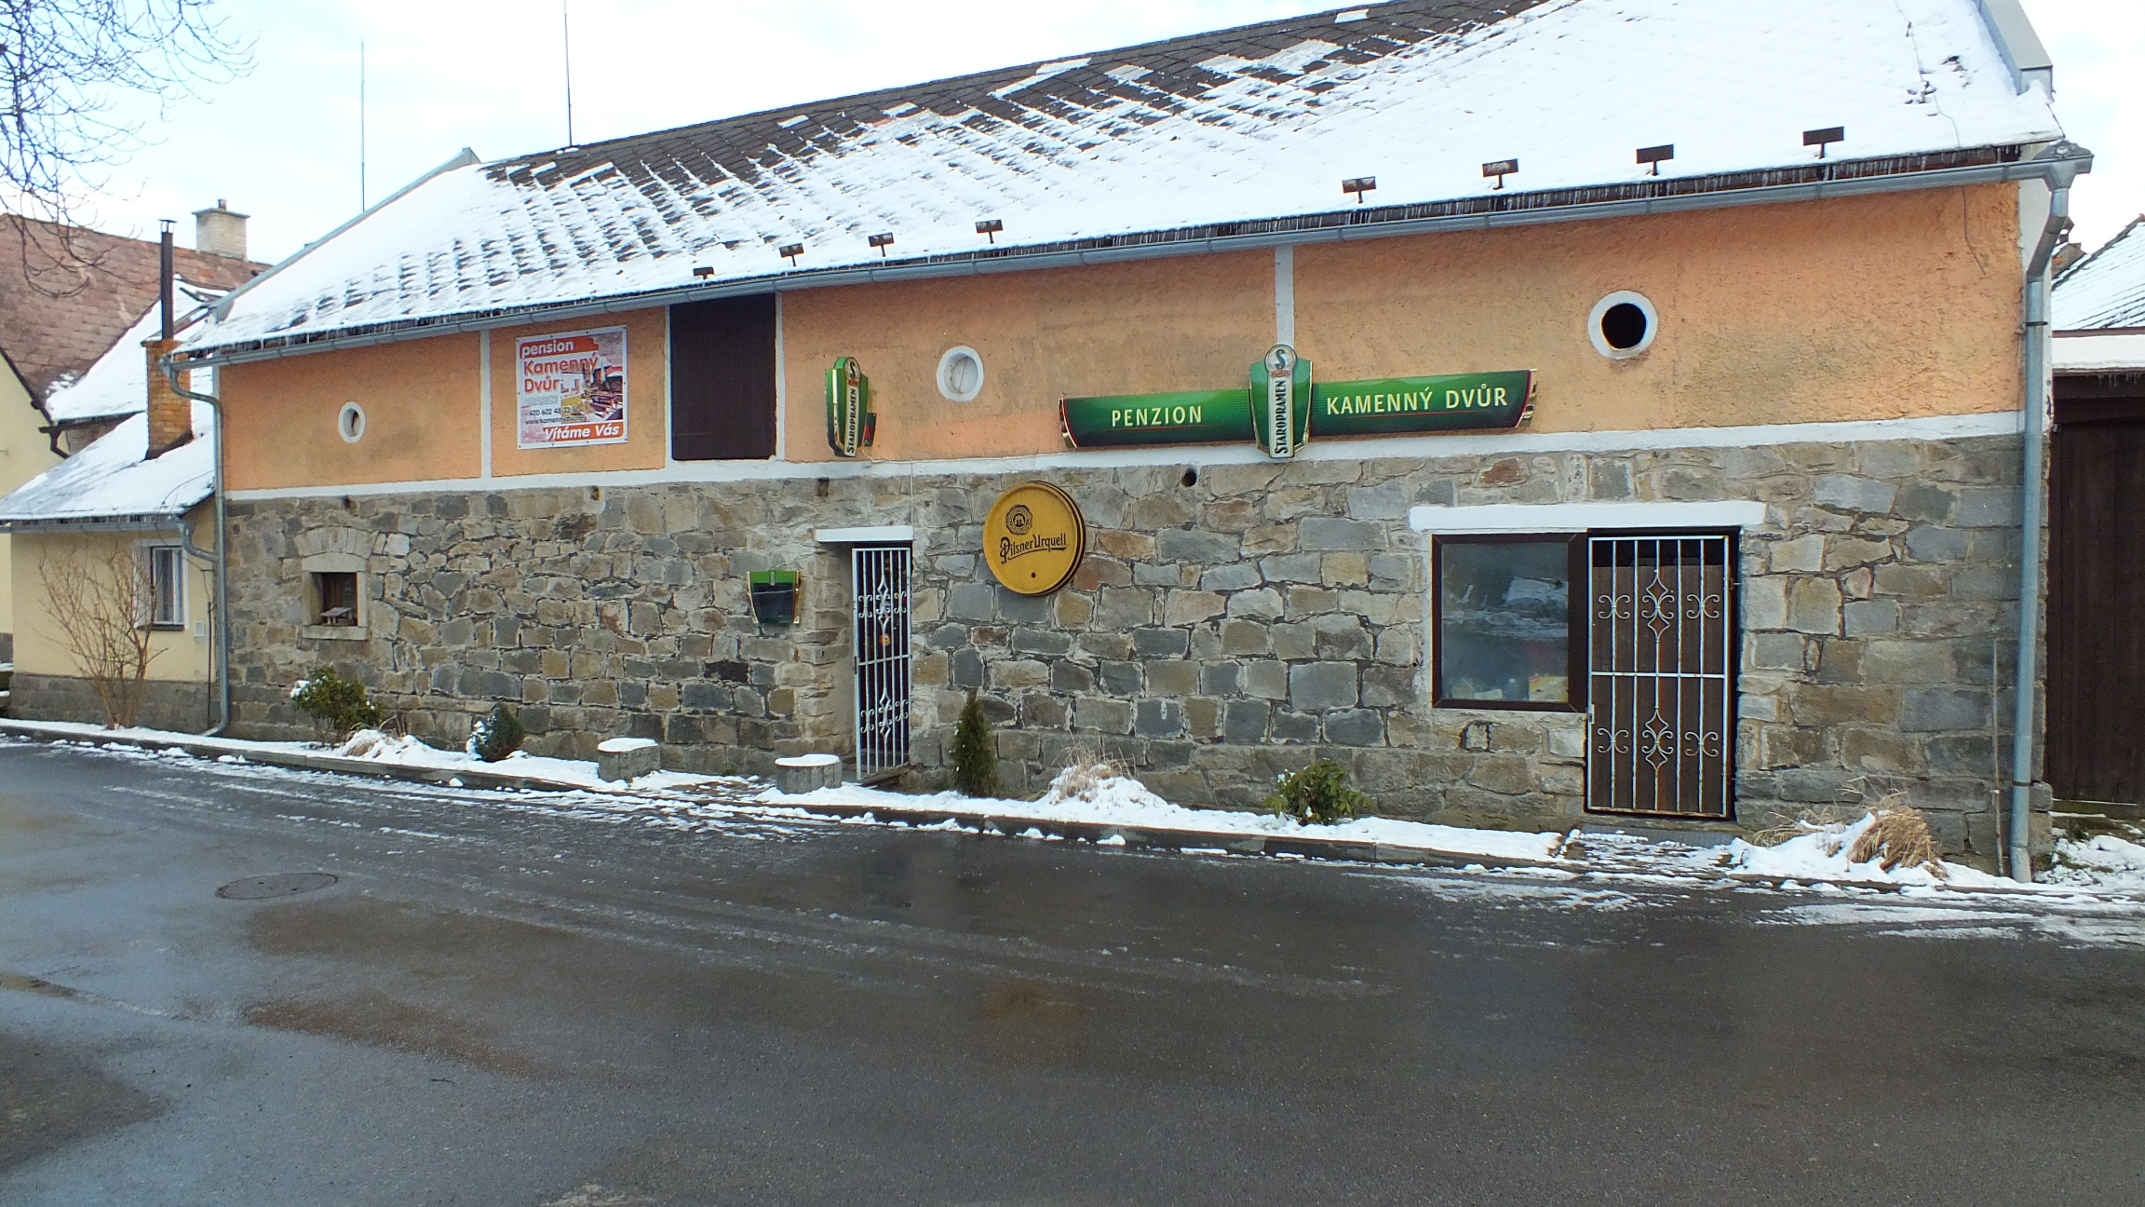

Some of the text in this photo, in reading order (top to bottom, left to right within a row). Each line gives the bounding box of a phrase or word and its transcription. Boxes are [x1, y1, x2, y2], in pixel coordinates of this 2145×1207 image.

[522, 340, 574, 359] pension
[523, 352, 599, 376] Kamenný
[524, 375, 560, 394] Dvůr
[1327, 383, 1508, 415] KAMENNÝ DVŮR
[1112, 405, 1202, 427] PENZION
[544, 423, 620, 440] Vítáme Vás
[1000, 533, 1066, 565] Pilsner Urquell
